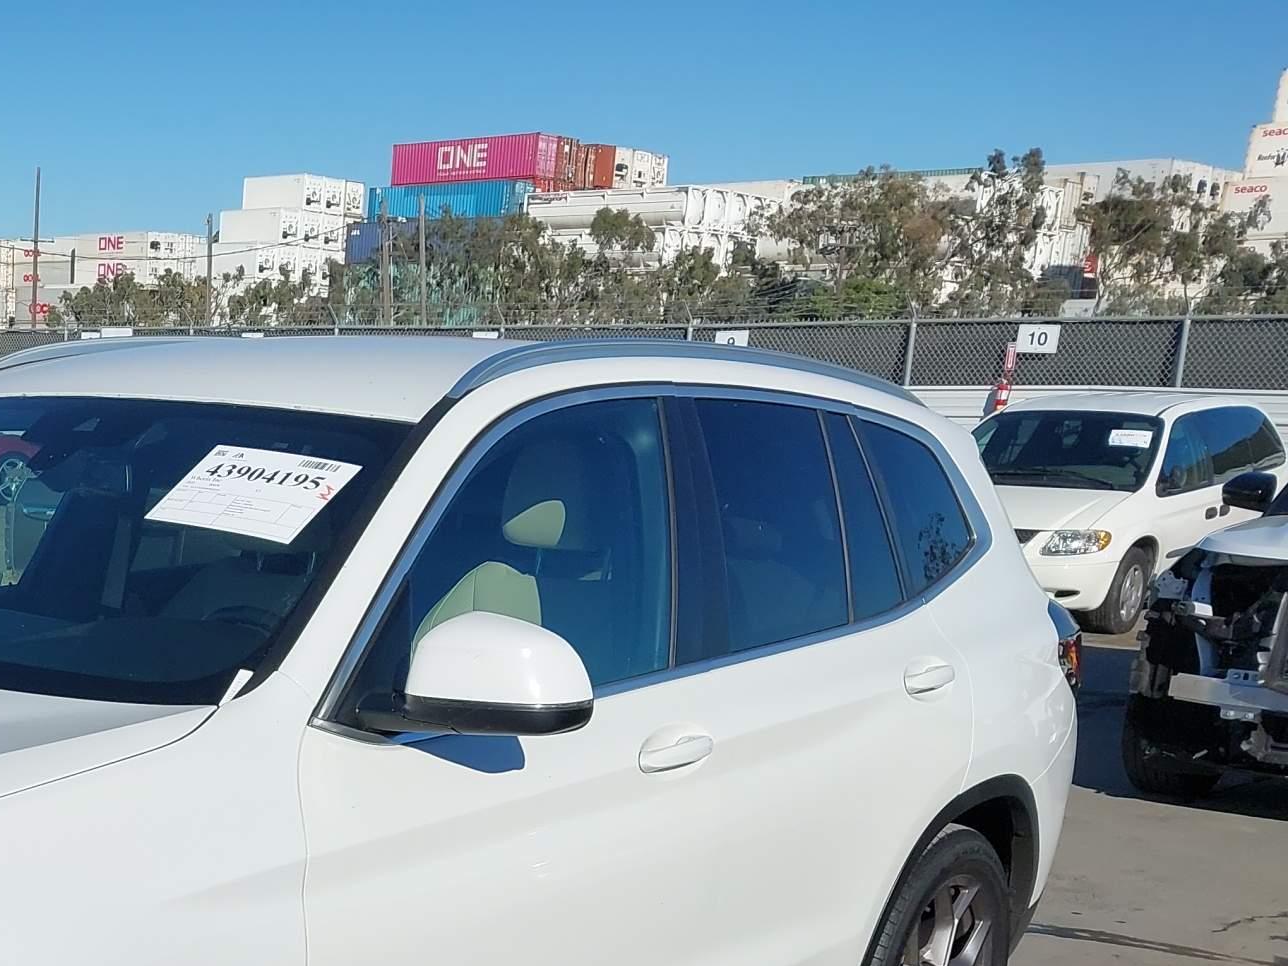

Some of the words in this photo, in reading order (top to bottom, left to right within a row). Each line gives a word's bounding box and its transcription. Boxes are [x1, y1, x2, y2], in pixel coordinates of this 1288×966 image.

[437, 143, 488, 170] ONE
[1234, 184, 1268, 194] seaco
[98, 236, 124, 251] ONE
[1028, 331, 1048, 346] 10
[206, 463, 326, 490] 43904195
